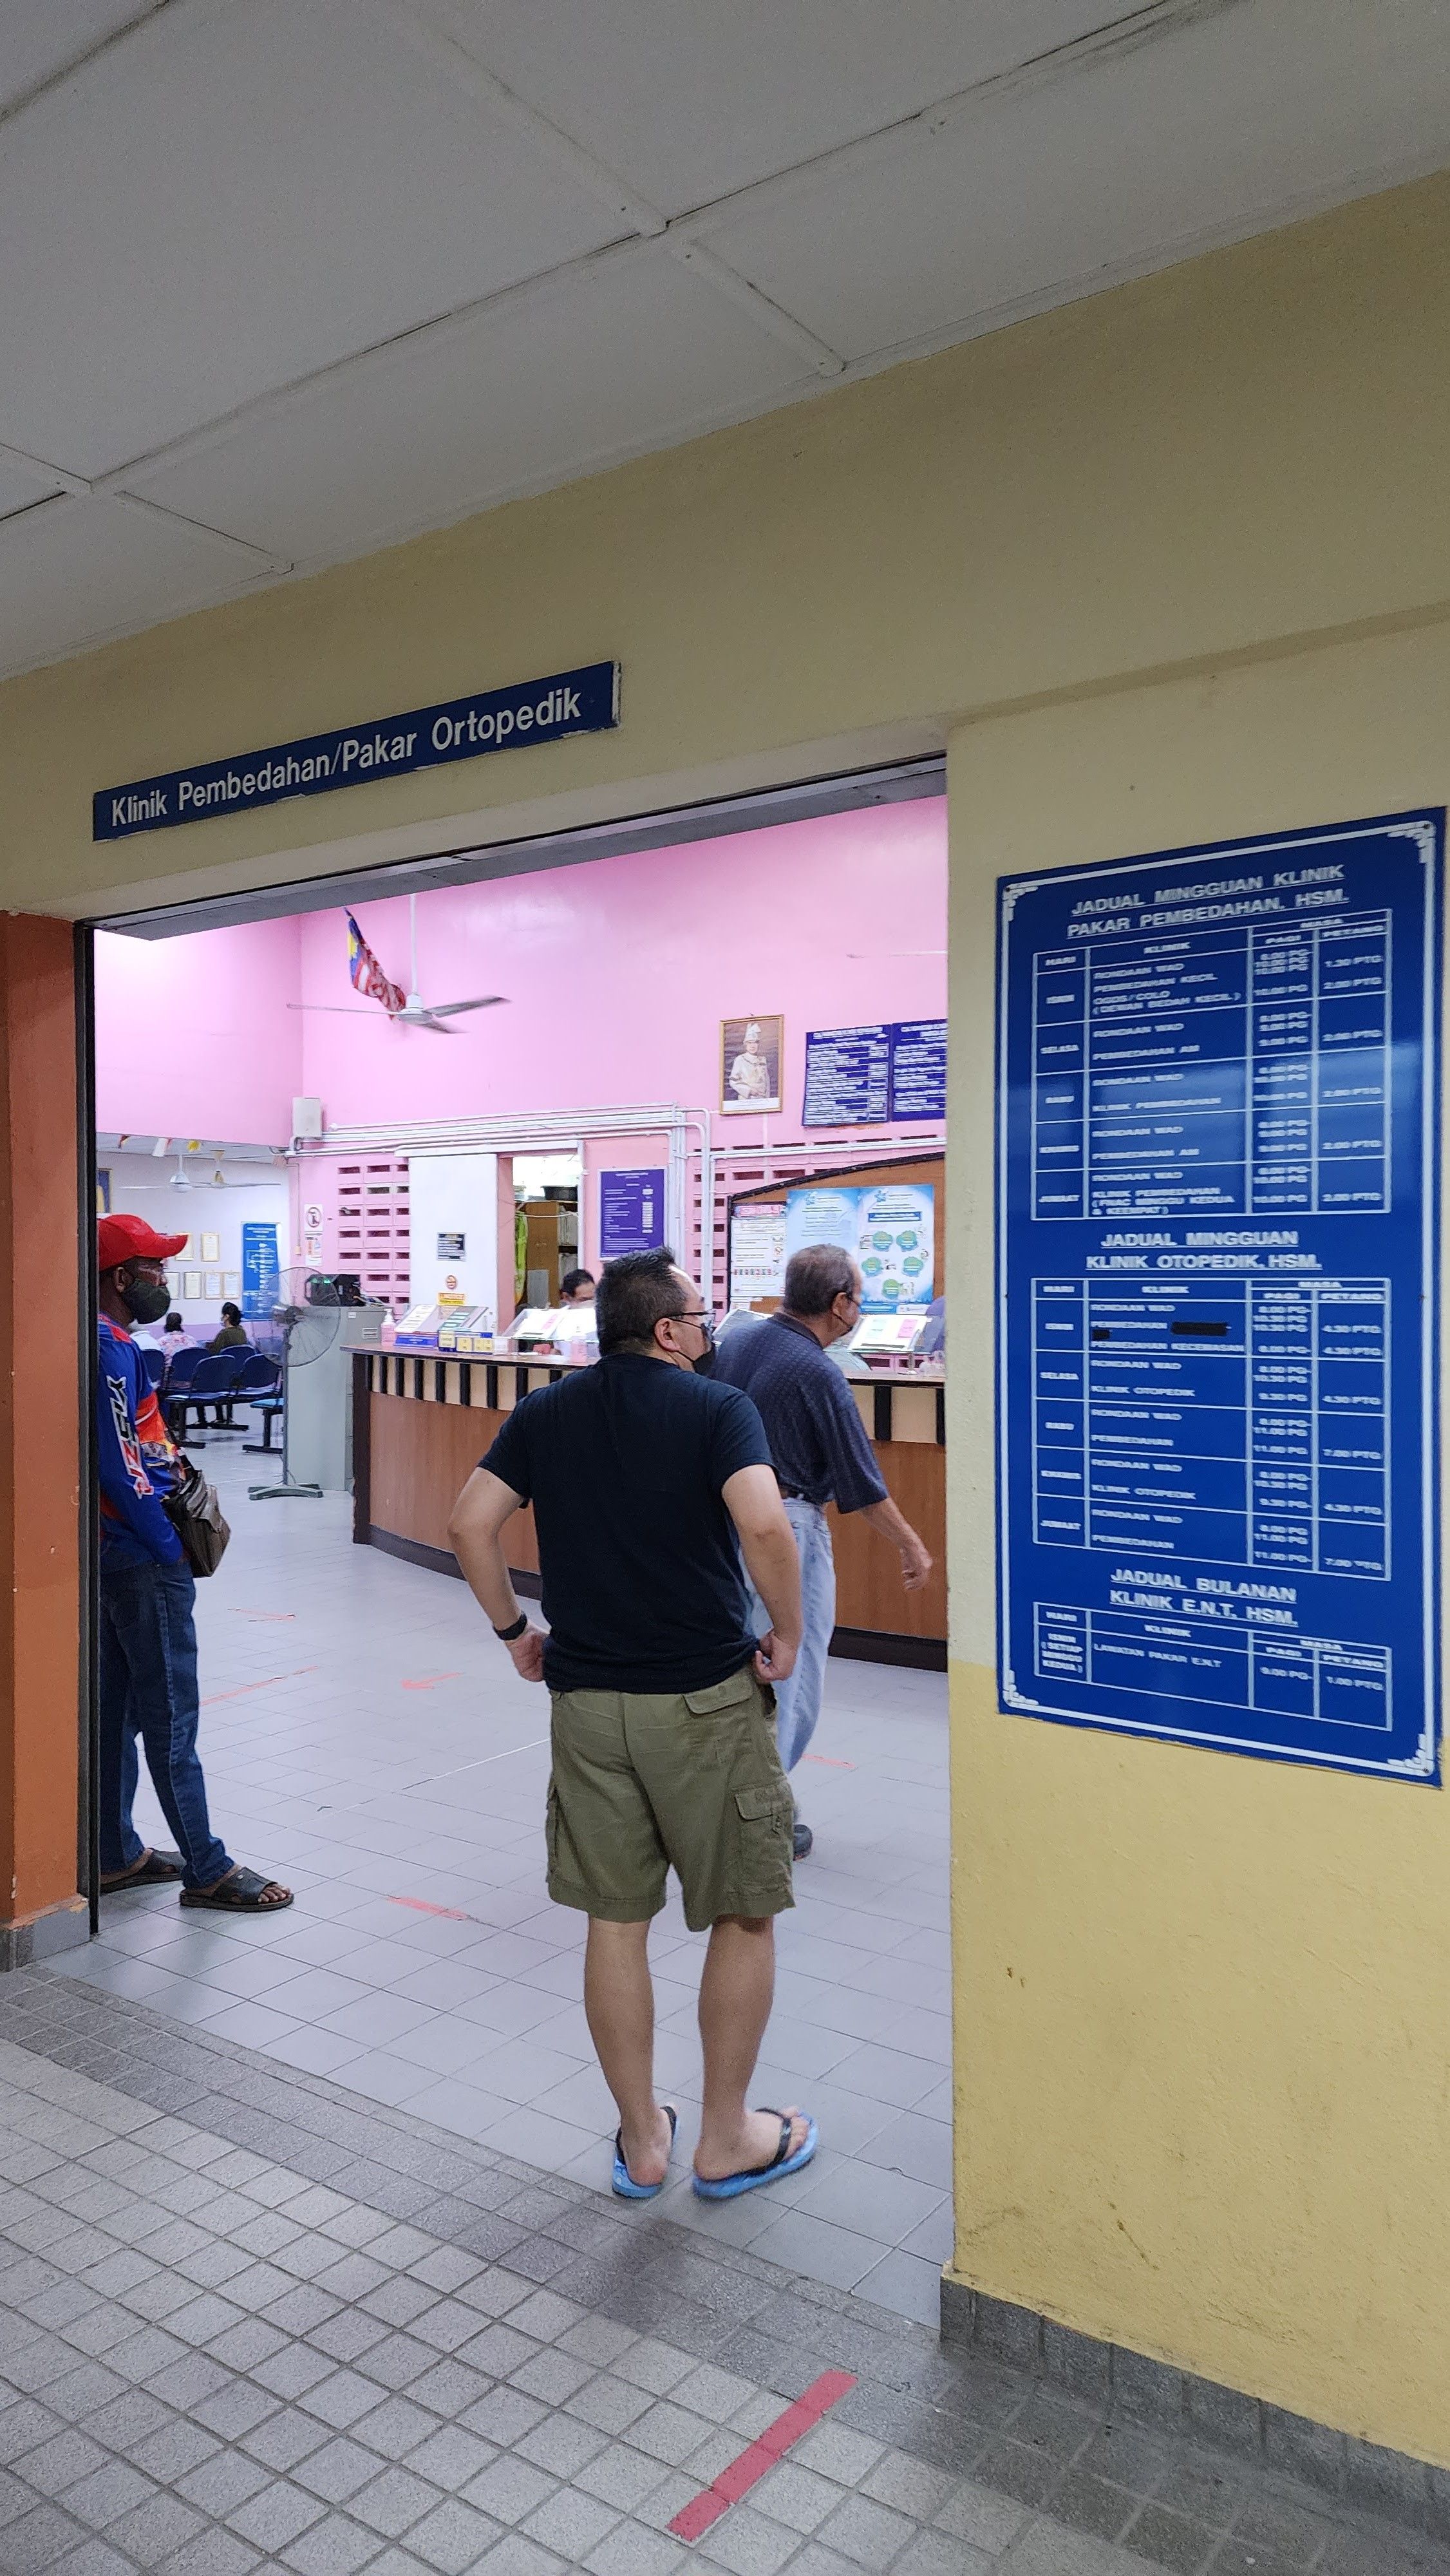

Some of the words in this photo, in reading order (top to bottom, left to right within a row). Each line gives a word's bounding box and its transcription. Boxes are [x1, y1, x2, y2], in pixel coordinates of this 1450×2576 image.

[111, 790, 168, 826] Klinik
[178, 728, 417, 811] Pembedahan/Pakar
[431, 687, 582, 750] Ortopedik
[1071, 895, 1144, 915] JADUAL
[1154, 876, 1262, 902] MINGGUAN
[1273, 864, 1346, 886] KLINIK
[1067, 916, 1130, 936] PAKAR
[1101, 1234, 1176, 1247] JADUAL
[1185, 1231, 1298, 1245] MINGGUAN
[1086, 1256, 1147, 1268] KLINIK
[1111, 1569, 1187, 1589] JADUAL
[1196, 1577, 1296, 1602] BULANAN
[1110, 1590, 1172, 1610] KLINIK
[1182, 1599, 1237, 1618] E.N.T.
